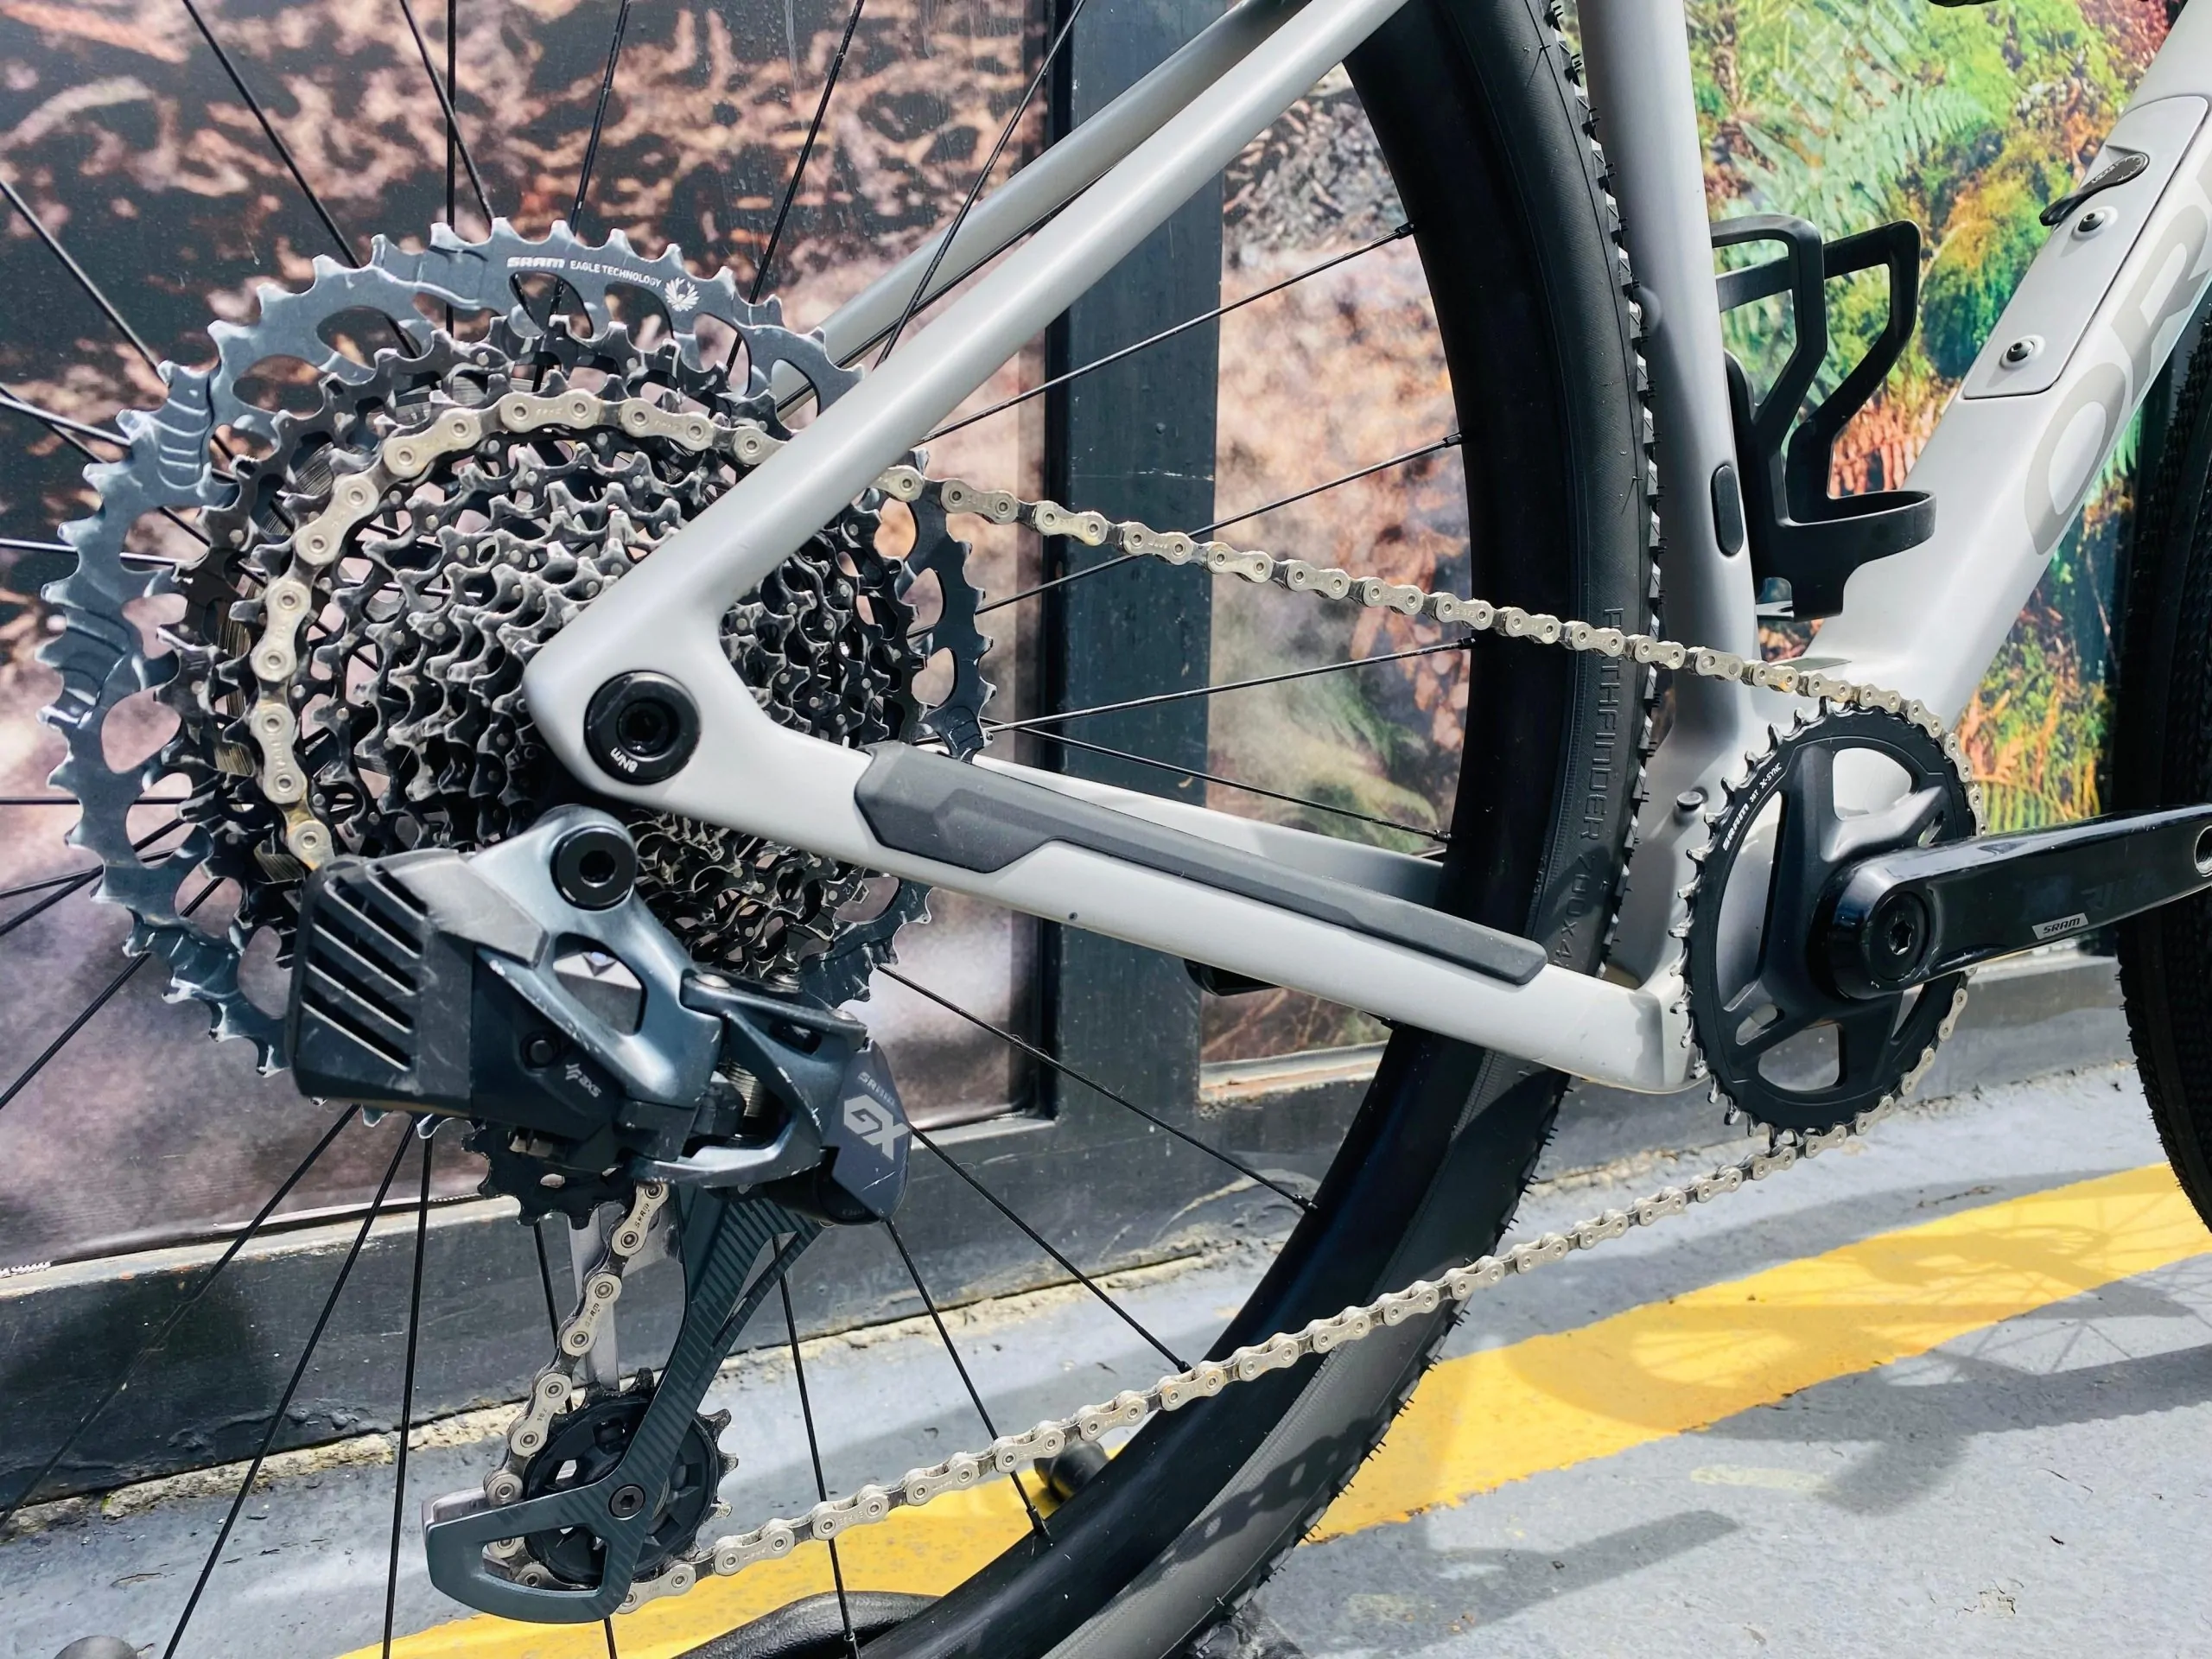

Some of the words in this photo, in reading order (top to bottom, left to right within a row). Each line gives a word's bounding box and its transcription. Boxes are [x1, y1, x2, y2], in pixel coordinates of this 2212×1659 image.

[507, 257, 566, 269] SRAM
[569, 260, 601, 274] EAGLE
[601, 264, 662, 288] TECHNOLOGY
[1580, 607, 1624, 841] PTHFINDER
[1722, 803, 1750, 851] SRAM
[2043, 917, 2081, 934] SRAM
[844, 1094, 911, 1161] GX
